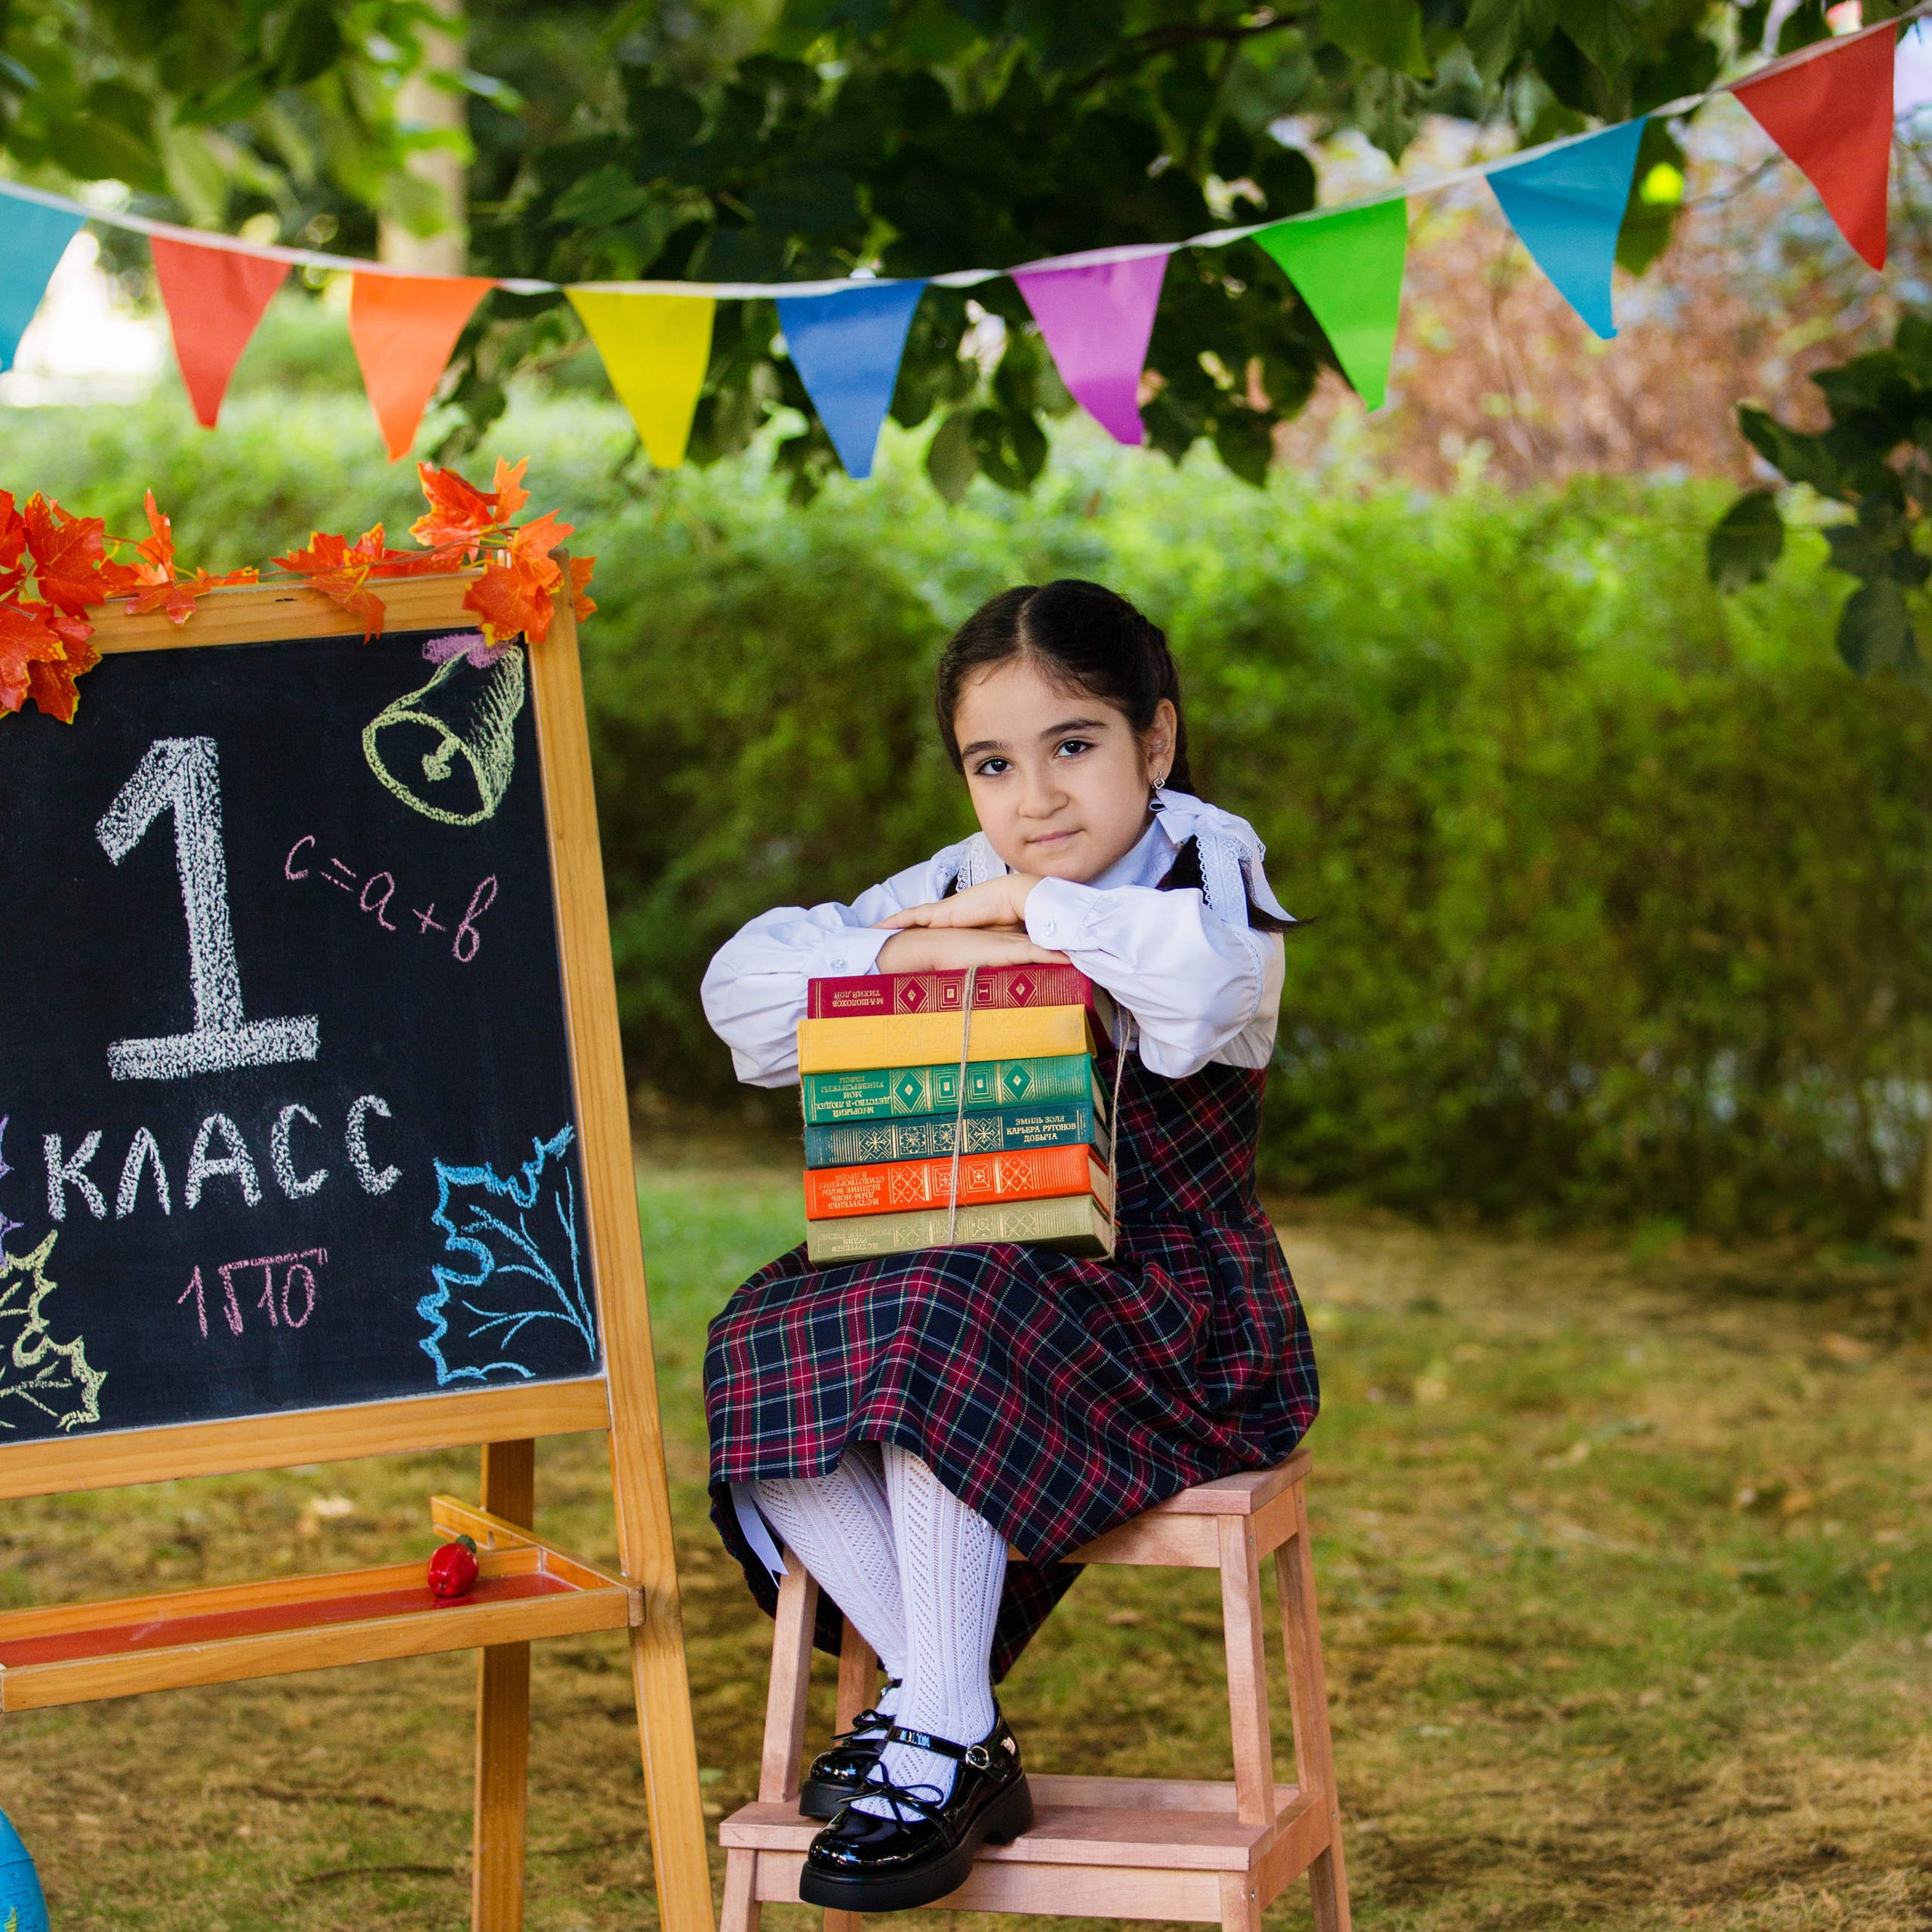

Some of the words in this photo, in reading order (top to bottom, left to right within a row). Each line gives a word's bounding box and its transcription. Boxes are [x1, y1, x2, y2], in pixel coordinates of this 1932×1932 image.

[95, 736, 321, 1081] 1
[834, 990, 851, 998] ДОН
[852, 990, 881, 998] ТИХИЙ
[821, 1081, 884, 1093] УНИВЕРСИТЕТЫ
[843, 1091, 862, 1099] МОИ
[1016, 1117, 1043, 1125] ЭМИЛЬ
[1007, 1126, 1041, 1135] КАРЬЕРА
[1042, 1123, 1076, 1132] РУГОНОВ
[1023, 1133, 1058, 1143] ДОБЫЧА
[43, 1094, 401, 1221] КЛАСС
[822, 1188, 844, 1196] ВОДЫ
[846, 1183, 881, 1193] ВЕШНИЕ
